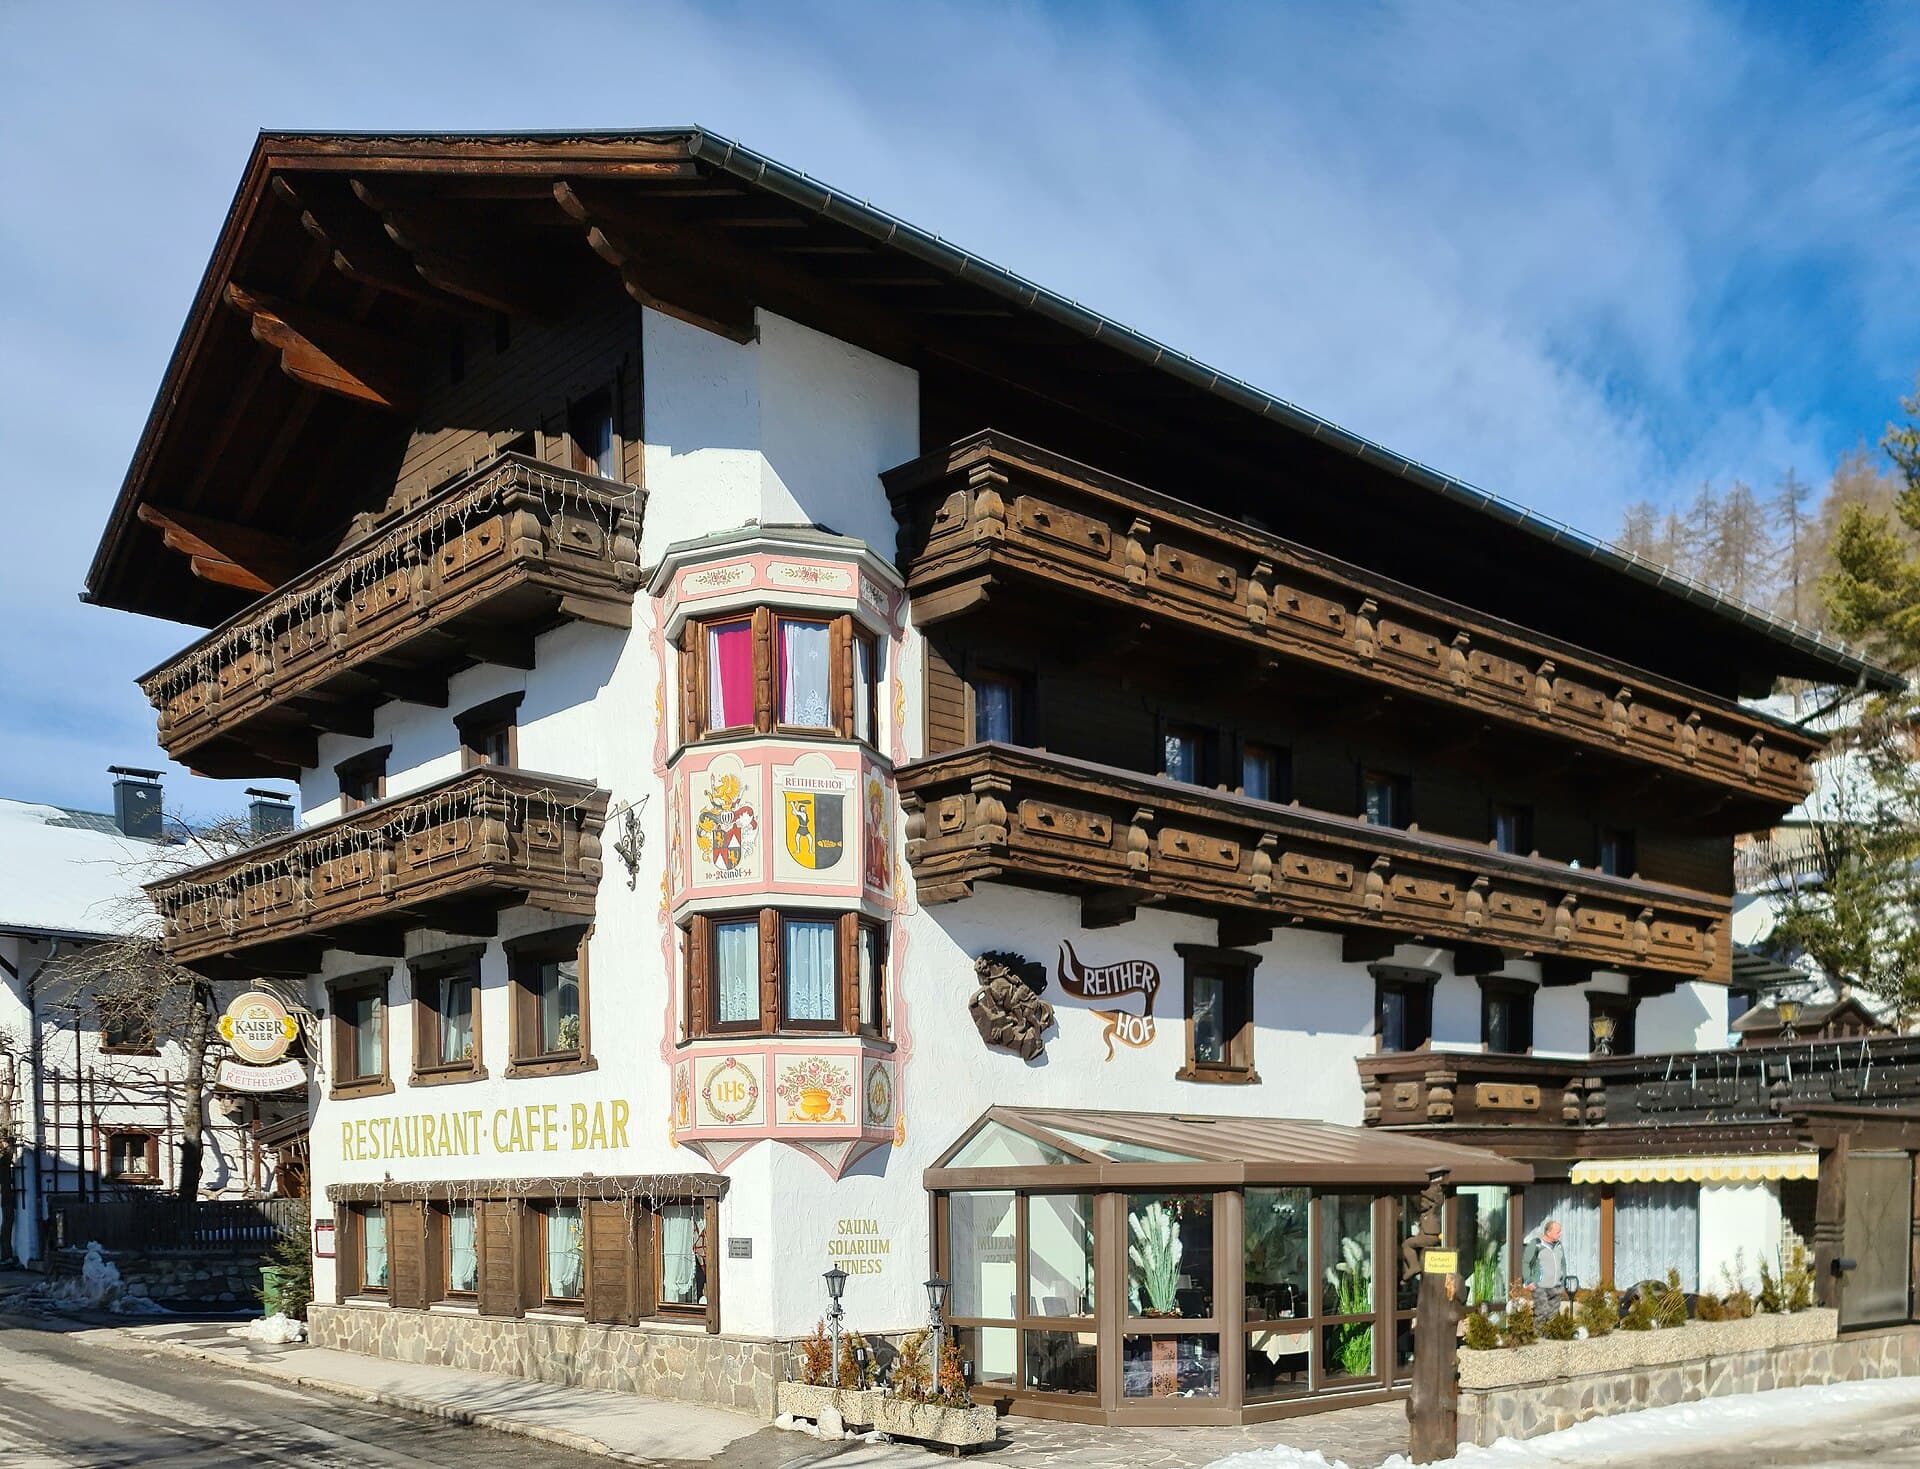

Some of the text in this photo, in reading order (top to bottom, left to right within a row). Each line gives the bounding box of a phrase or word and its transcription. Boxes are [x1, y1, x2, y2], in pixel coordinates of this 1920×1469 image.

[235, 1020, 285, 1035] KAISER
[1116, 1012, 1154, 1044] HOF
[248, 1033, 275, 1041] BIER
[225, 1071, 297, 1087] REITHERHOF
[717, 1080, 745, 1103] IHS
[341, 1099, 630, 1161] RESTAURANT CAFE BAR
[837, 1219, 879, 1235] SAUNA
[828, 1239, 890, 1256] SOLARIUM
